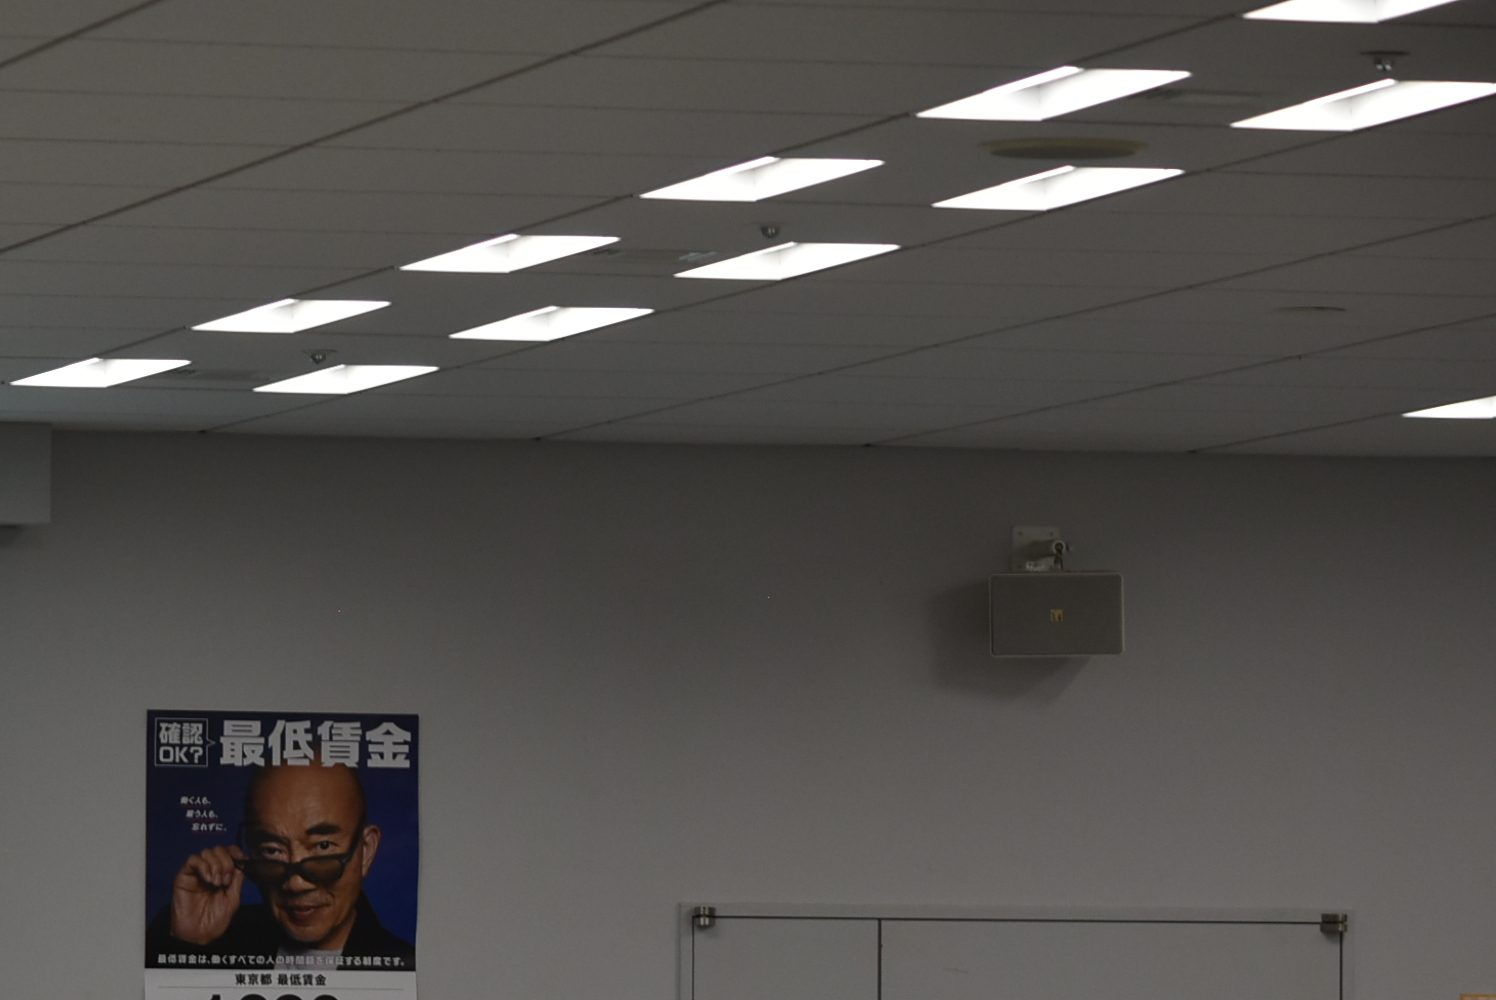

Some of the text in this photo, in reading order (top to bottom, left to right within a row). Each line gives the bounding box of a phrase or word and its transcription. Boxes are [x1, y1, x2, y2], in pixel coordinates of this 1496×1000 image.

[158, 721, 204, 745] 確認
[219, 719, 412, 768] 最低賃金
[159, 746, 204, 764] OK?
[235, 974, 327, 987] 東京都 最低賃金
